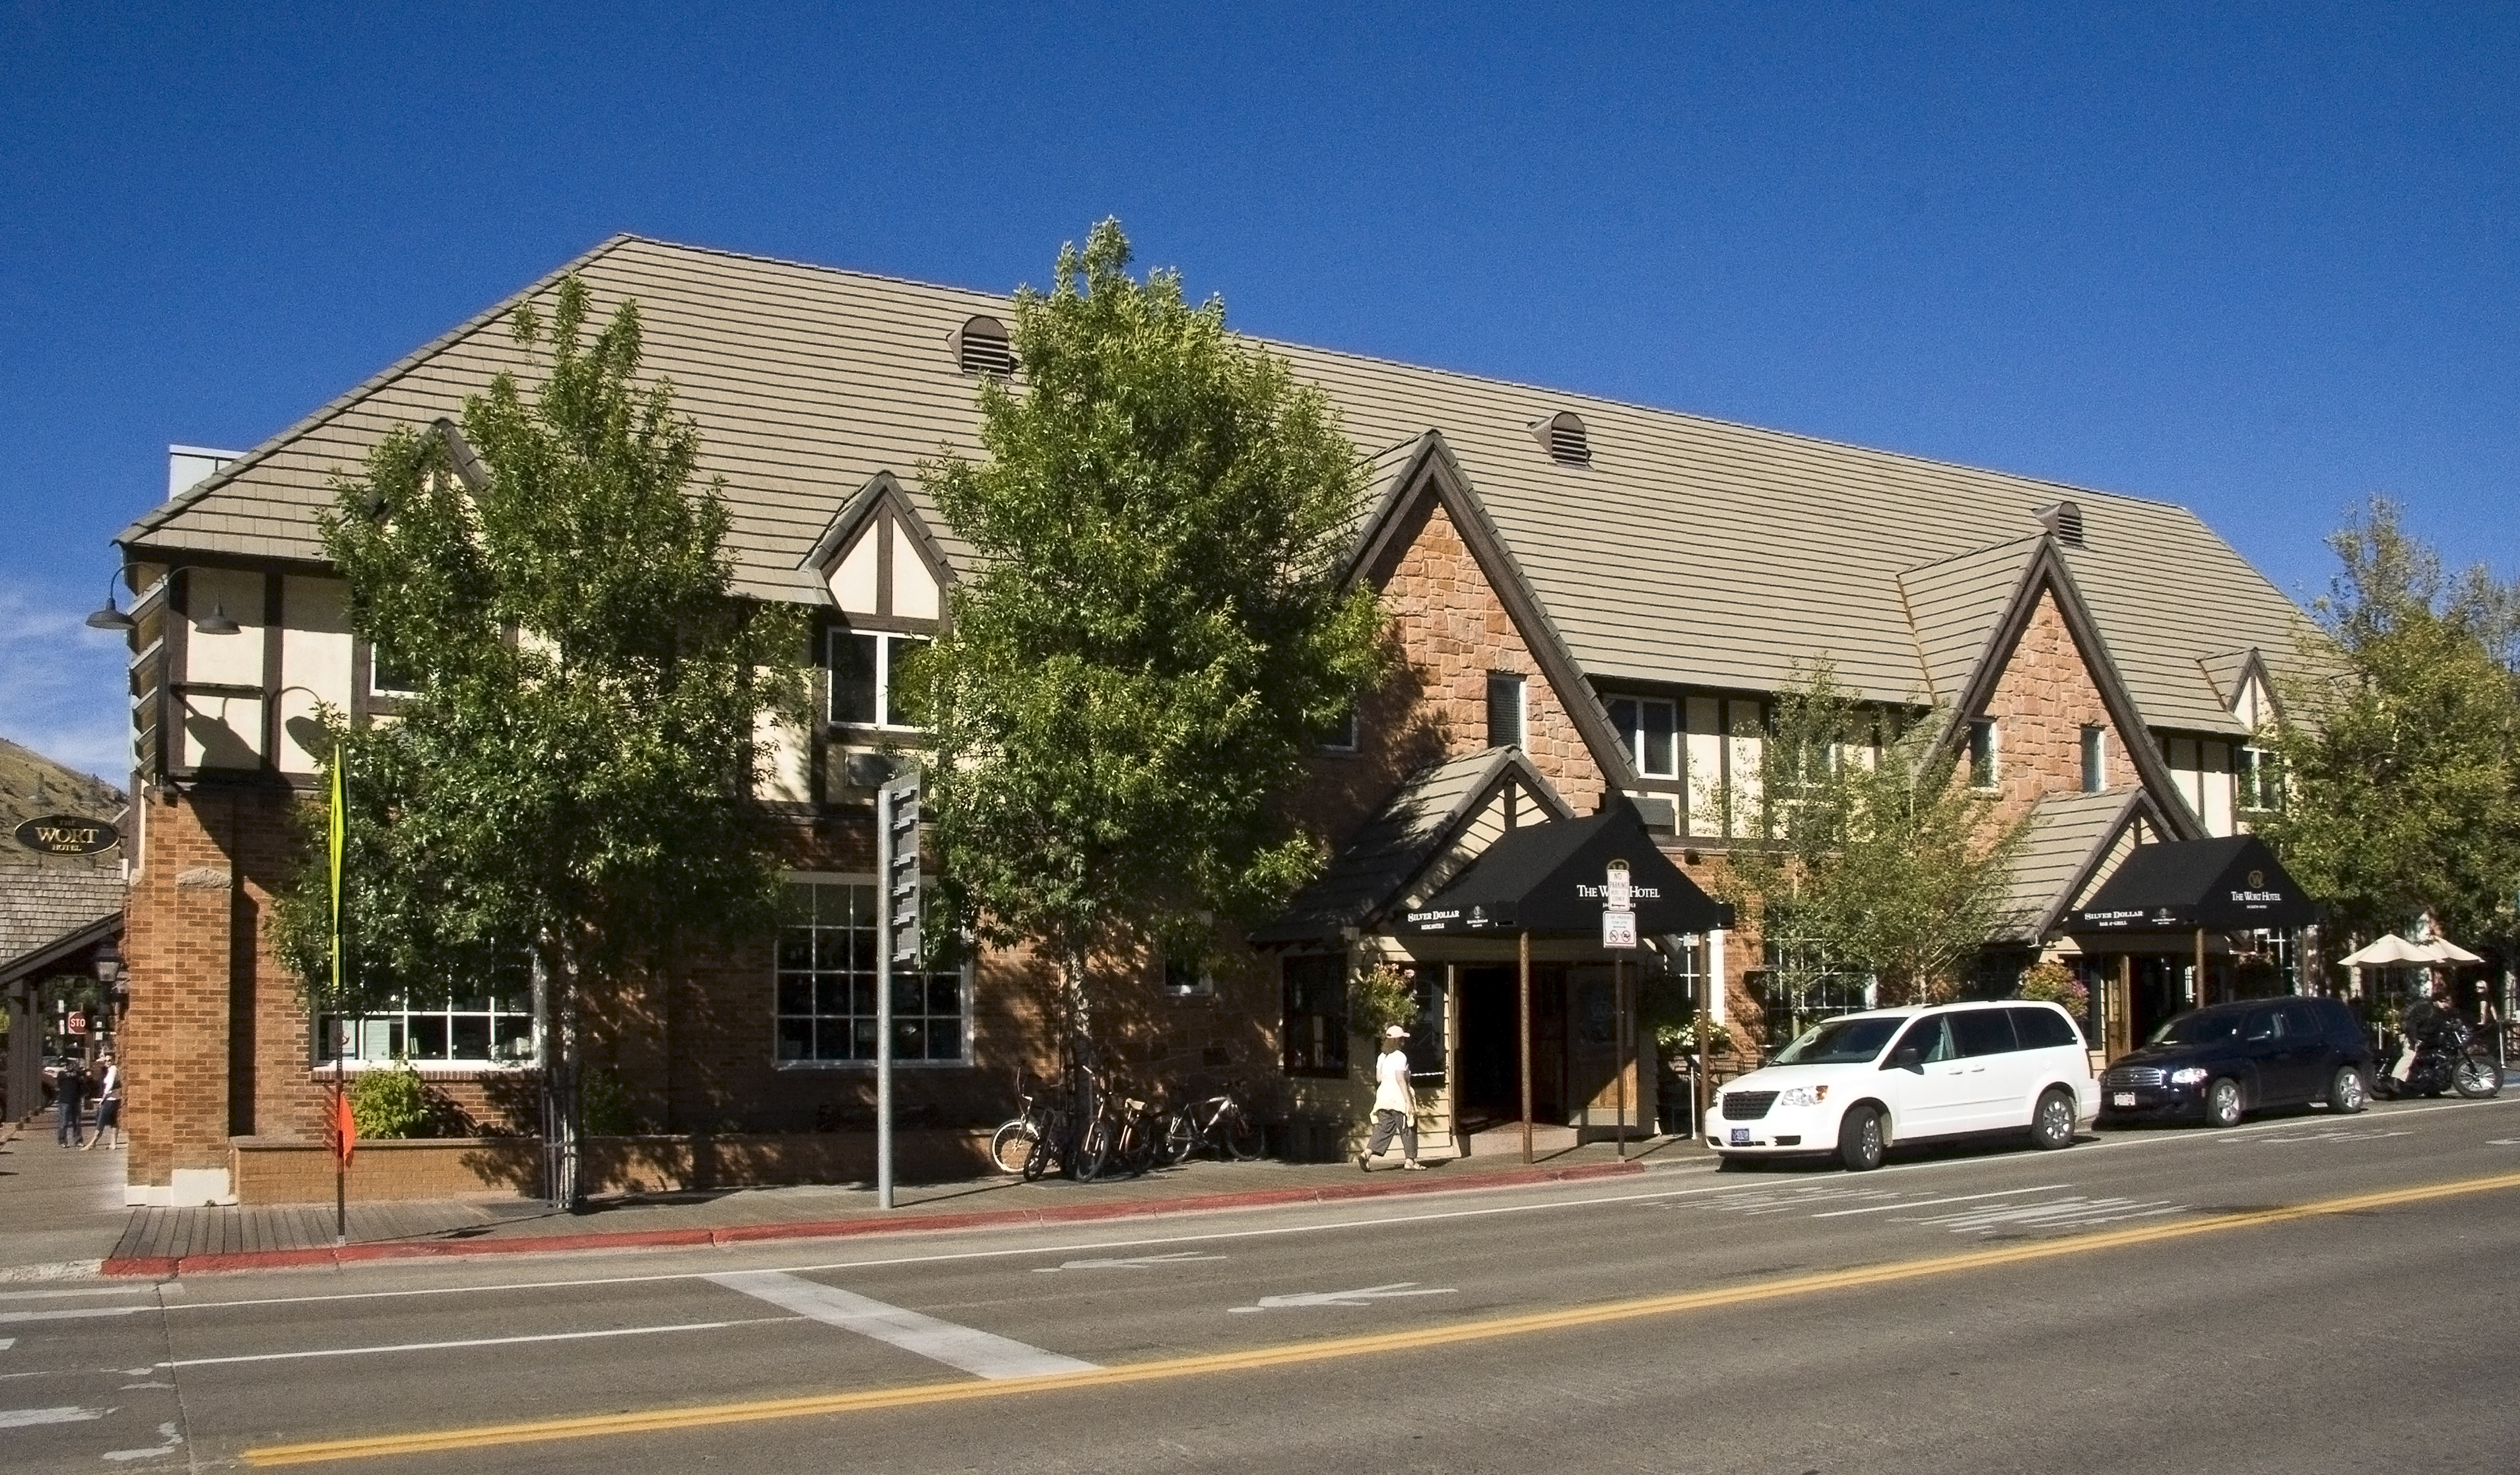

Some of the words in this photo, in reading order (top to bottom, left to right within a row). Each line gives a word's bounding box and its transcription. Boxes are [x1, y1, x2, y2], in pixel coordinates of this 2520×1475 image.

[35, 827, 99, 843] WORT
[1576, 884, 1597, 897] THE
[1629, 886, 1660, 898] HOTEL
[2231, 891, 2243, 901] THE
[2262, 891, 2281, 901] HOTEL
[1408, 913, 1432, 922] SILVER
[1432, 910, 1459, 920] DOLLAR
